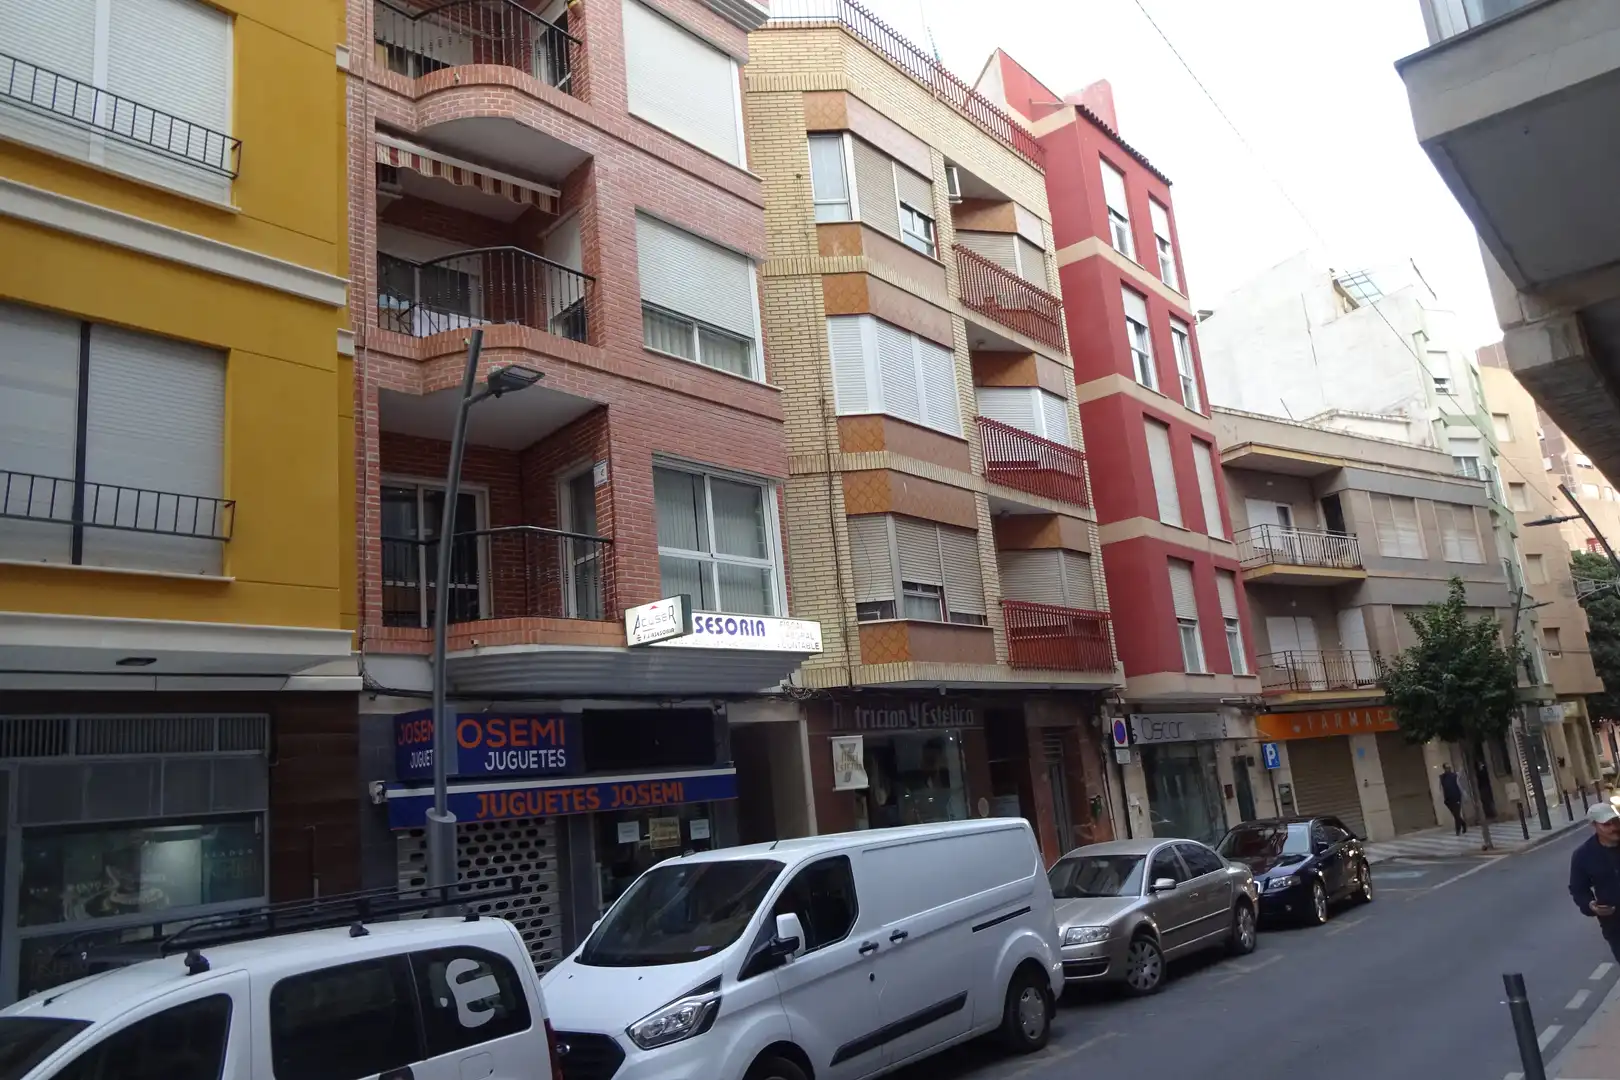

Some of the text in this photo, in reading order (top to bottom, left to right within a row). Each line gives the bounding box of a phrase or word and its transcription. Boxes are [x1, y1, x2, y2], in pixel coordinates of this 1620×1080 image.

[694, 616, 766, 637] SESORIA
[1307, 710, 1386, 732] FARMAC
[398, 719, 434, 746] JOSEM
[457, 718, 565, 749] OSEMI
[410, 750, 434, 769] JUGUET
[484, 749, 567, 771] JUGUETES
[1266, 743, 1277, 766] P
[476, 782, 684, 819] JUGUETES JOSEMI
